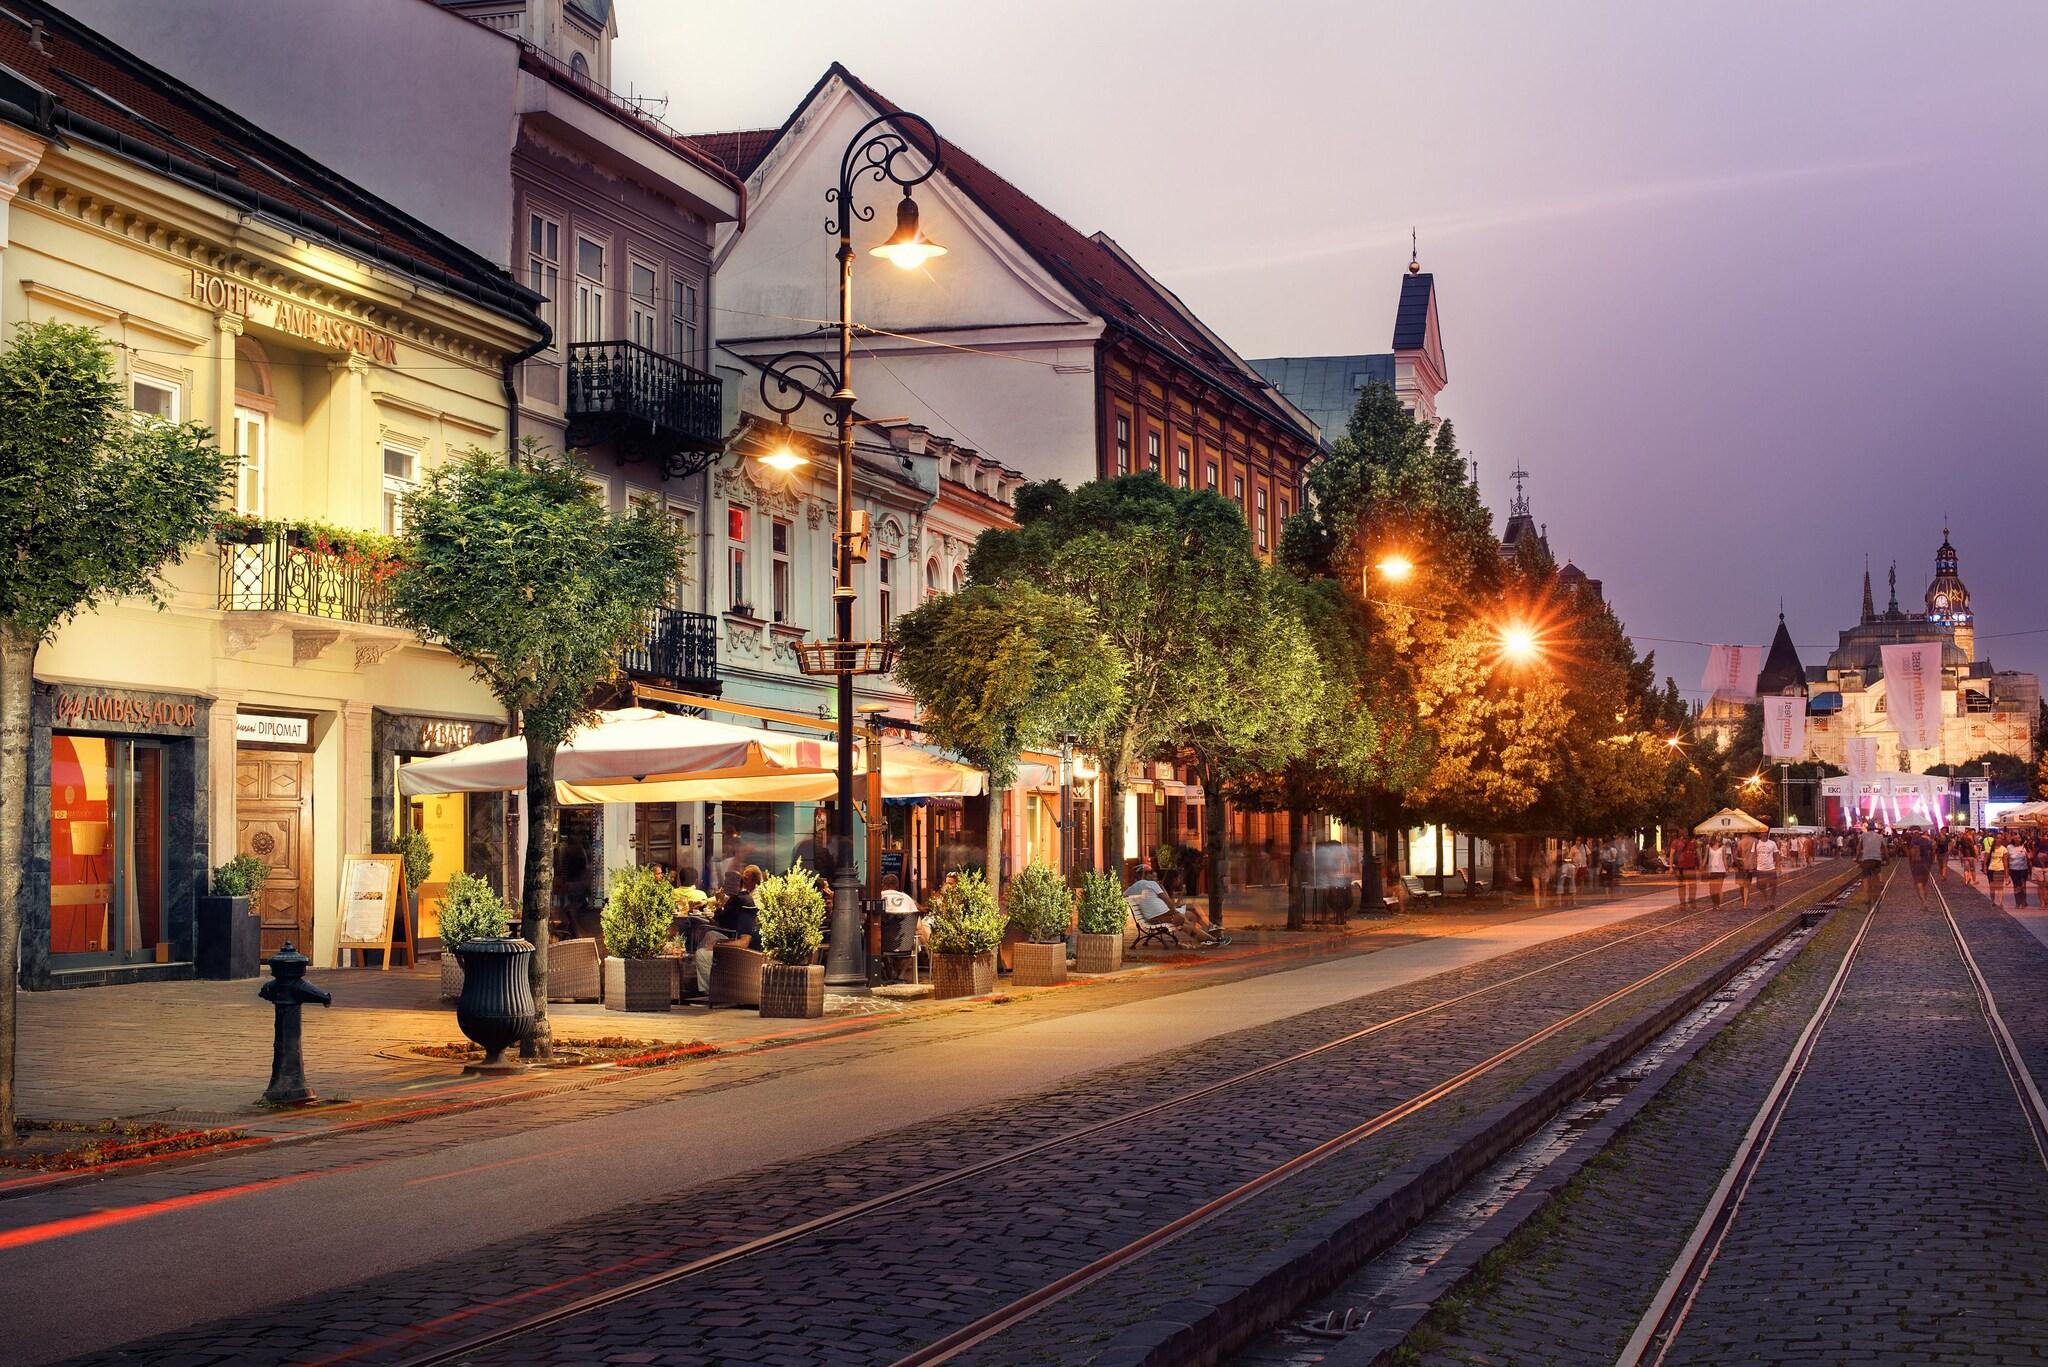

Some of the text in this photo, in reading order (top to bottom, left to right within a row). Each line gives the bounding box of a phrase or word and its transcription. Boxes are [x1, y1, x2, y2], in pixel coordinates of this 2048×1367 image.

[191, 269, 398, 365] HOTEL AMBASSADOR
[83, 695, 197, 728] AMBASSADOR
[258, 721, 302, 737] DIPLOMAT
[439, 724, 473, 745] BAYER
